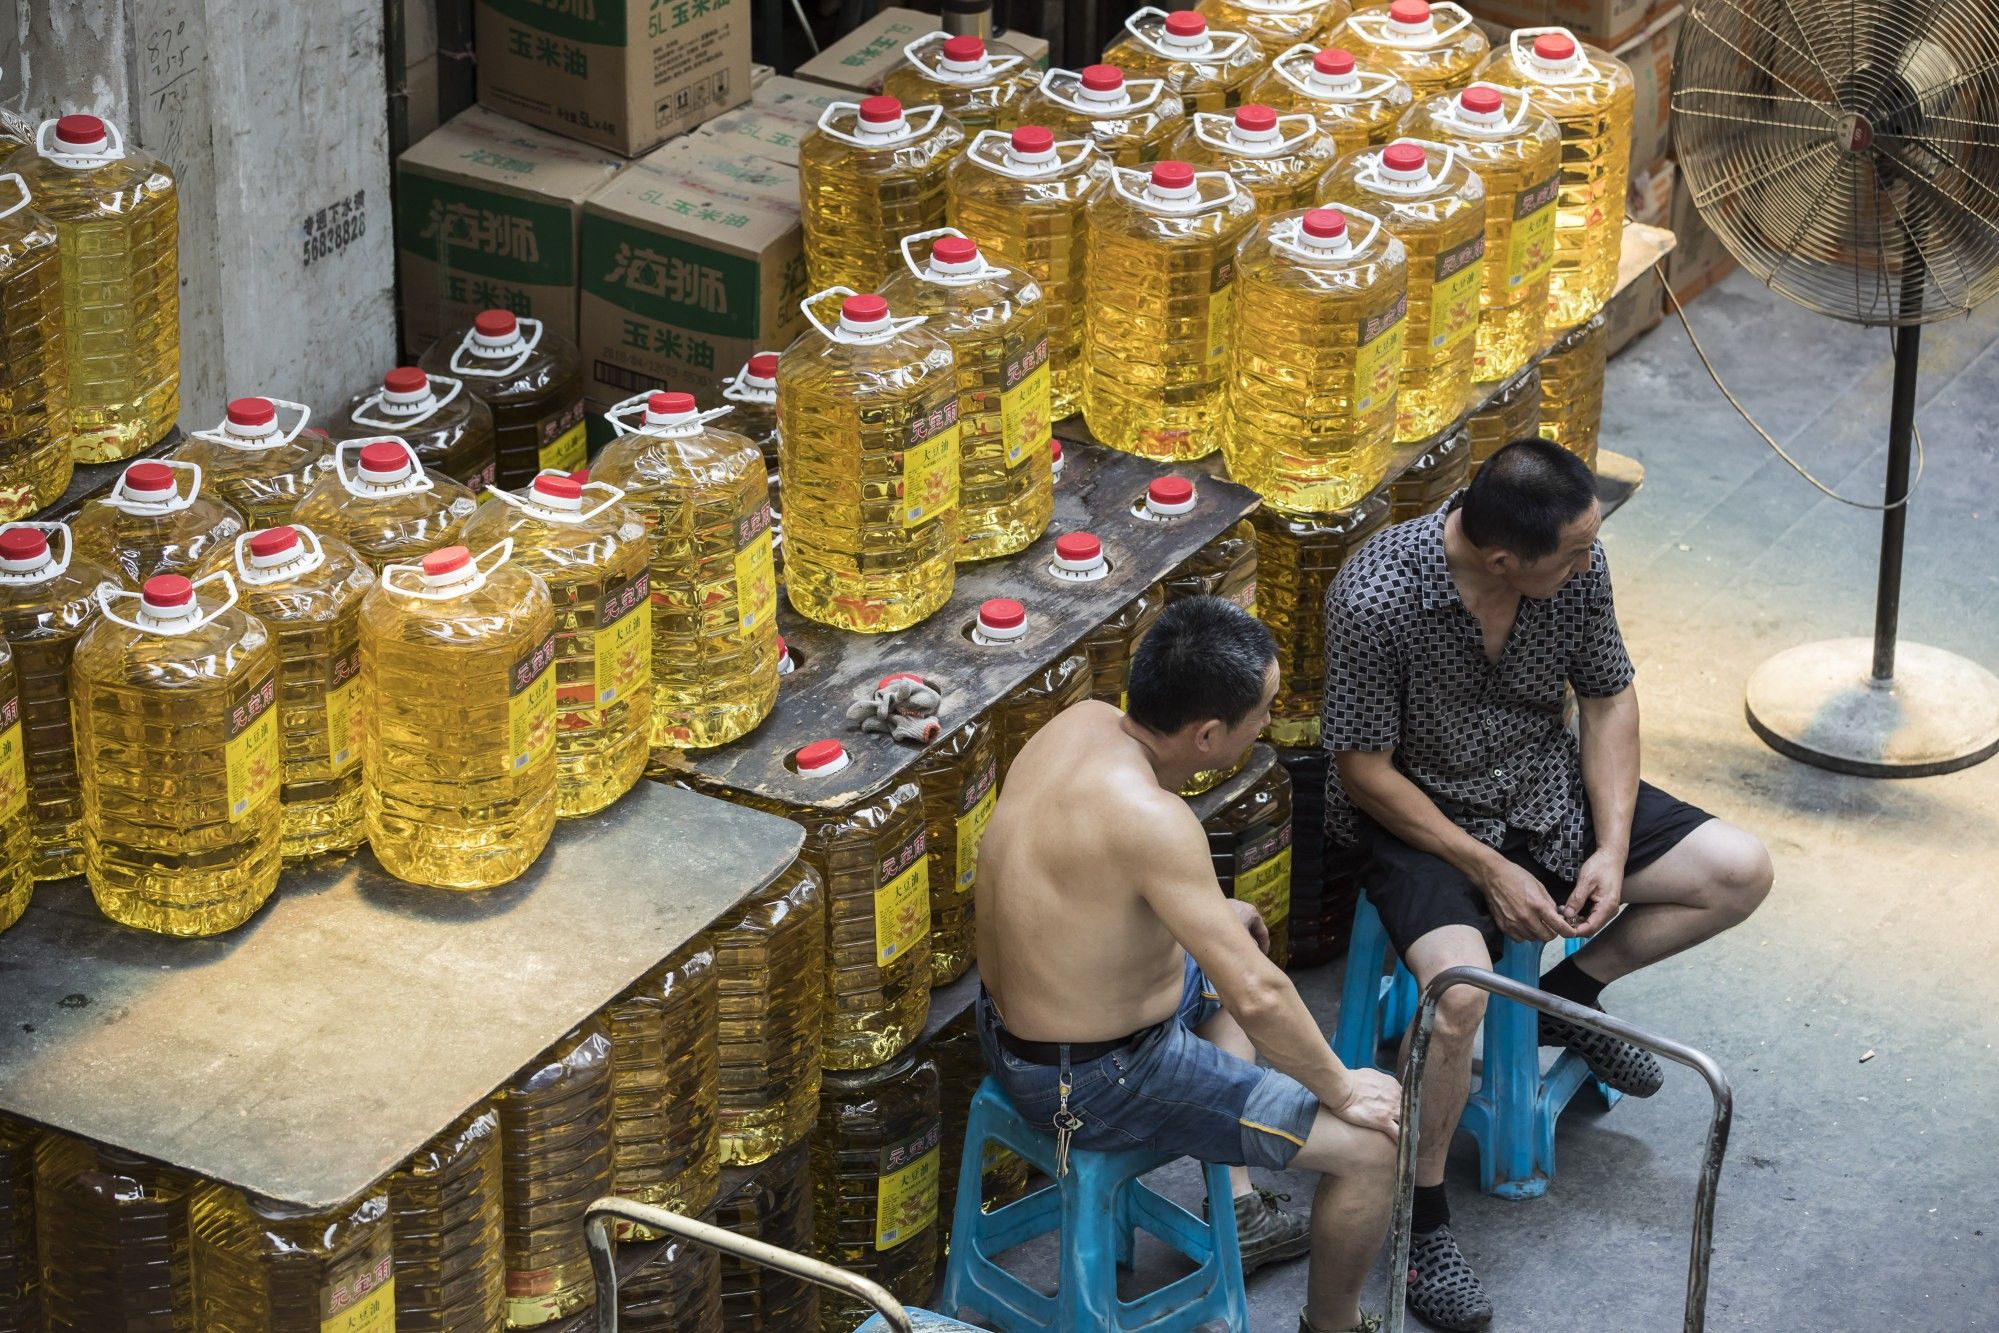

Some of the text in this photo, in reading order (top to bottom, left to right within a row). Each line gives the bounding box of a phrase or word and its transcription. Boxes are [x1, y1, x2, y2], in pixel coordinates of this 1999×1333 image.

[648, 12, 667, 38] 5L
[508, 27, 589, 79] 玉米油
[666, 199, 751, 229] 玉米油
[603, 242, 728, 315] 海狮
[622, 319, 715, 371] 玉米油
